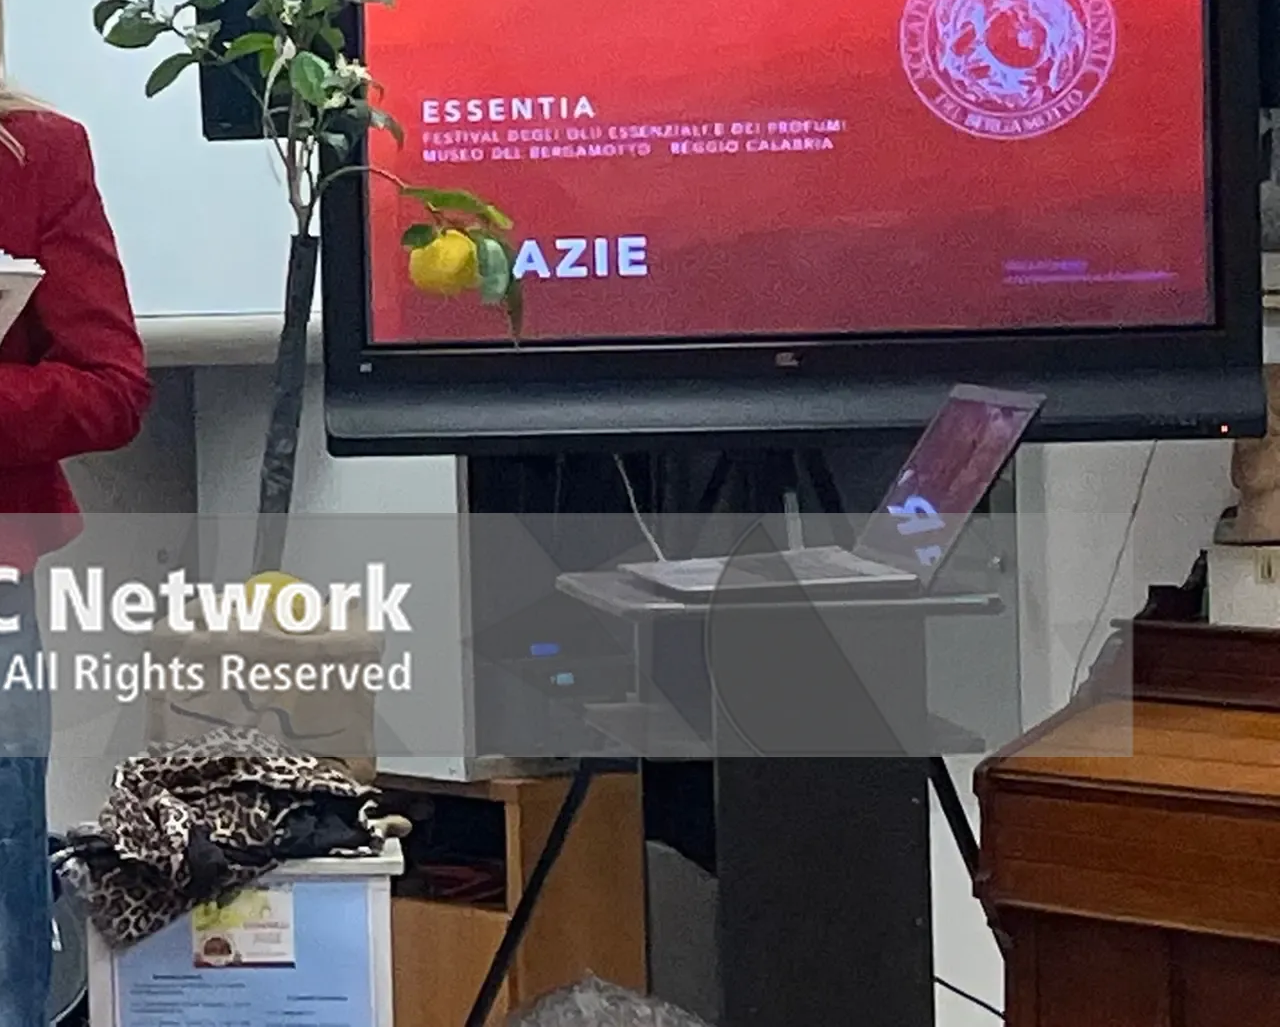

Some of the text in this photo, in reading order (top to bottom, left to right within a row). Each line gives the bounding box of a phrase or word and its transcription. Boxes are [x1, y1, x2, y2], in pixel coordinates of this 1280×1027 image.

[421, 94, 596, 124] ESSENTIA
[421, 128, 500, 146] FESTIVAL
[767, 119, 847, 134] PROFUMI
[422, 137, 834, 163] MUSEO DEL BERGAMOTTO REGGIO CALABRIA
[512, 234, 650, 280] AZIE
